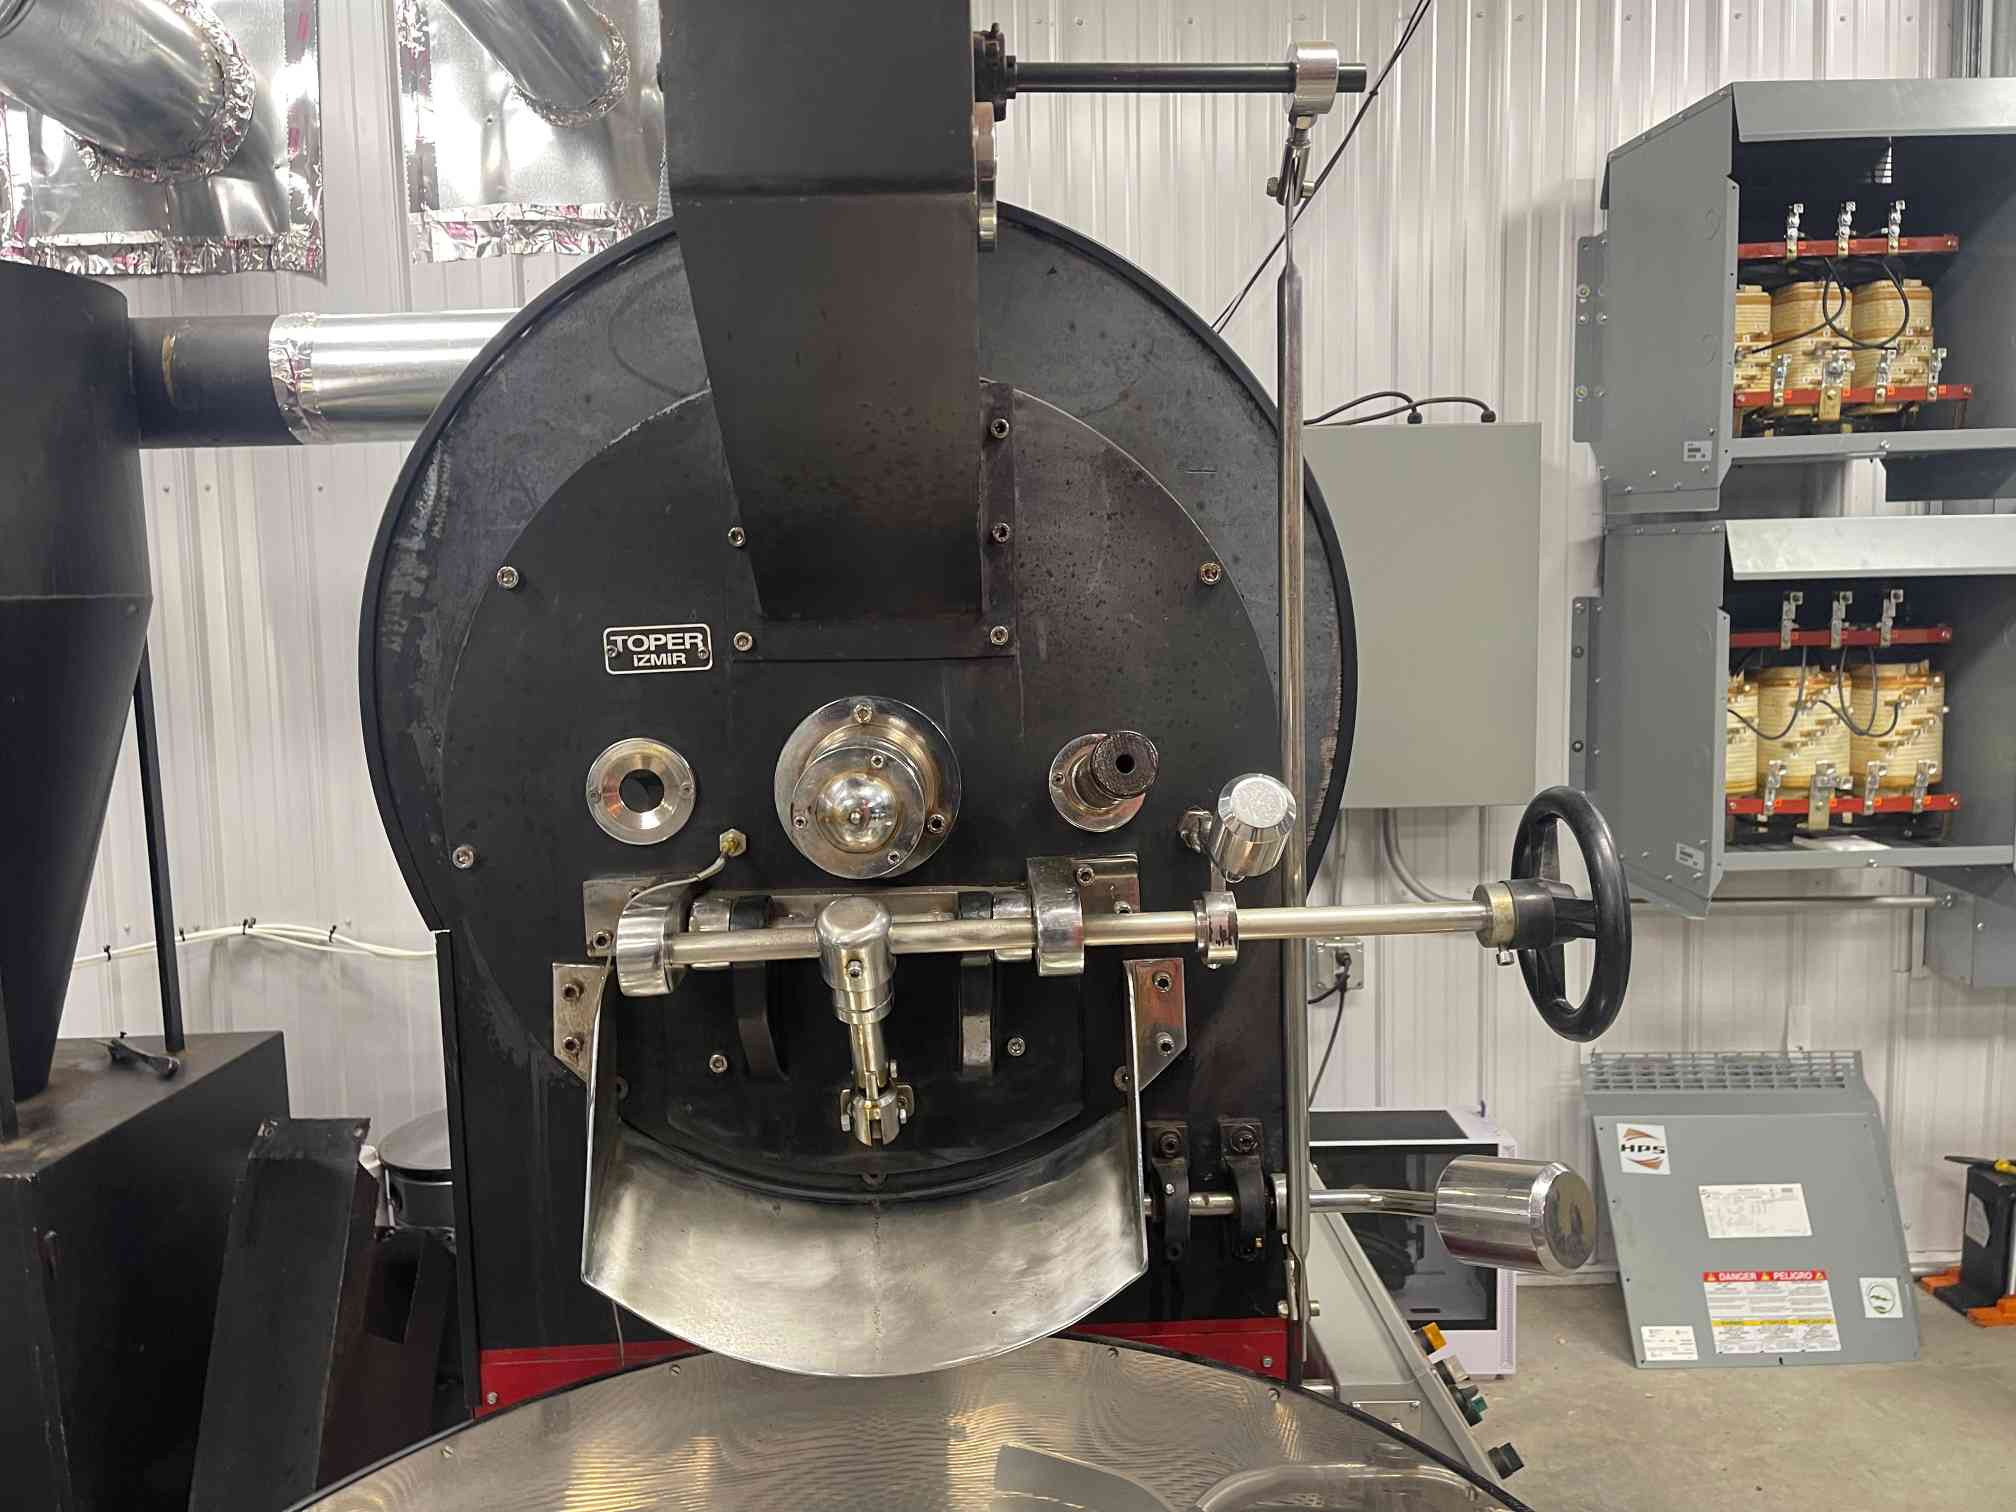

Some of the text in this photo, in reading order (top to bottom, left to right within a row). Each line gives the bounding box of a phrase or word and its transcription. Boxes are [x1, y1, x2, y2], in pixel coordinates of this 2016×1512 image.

[609, 632, 704, 653] TOPER
[1621, 1144, 1665, 1154] HPS
[1719, 1271, 1813, 1281] DANGER PELIGRO
